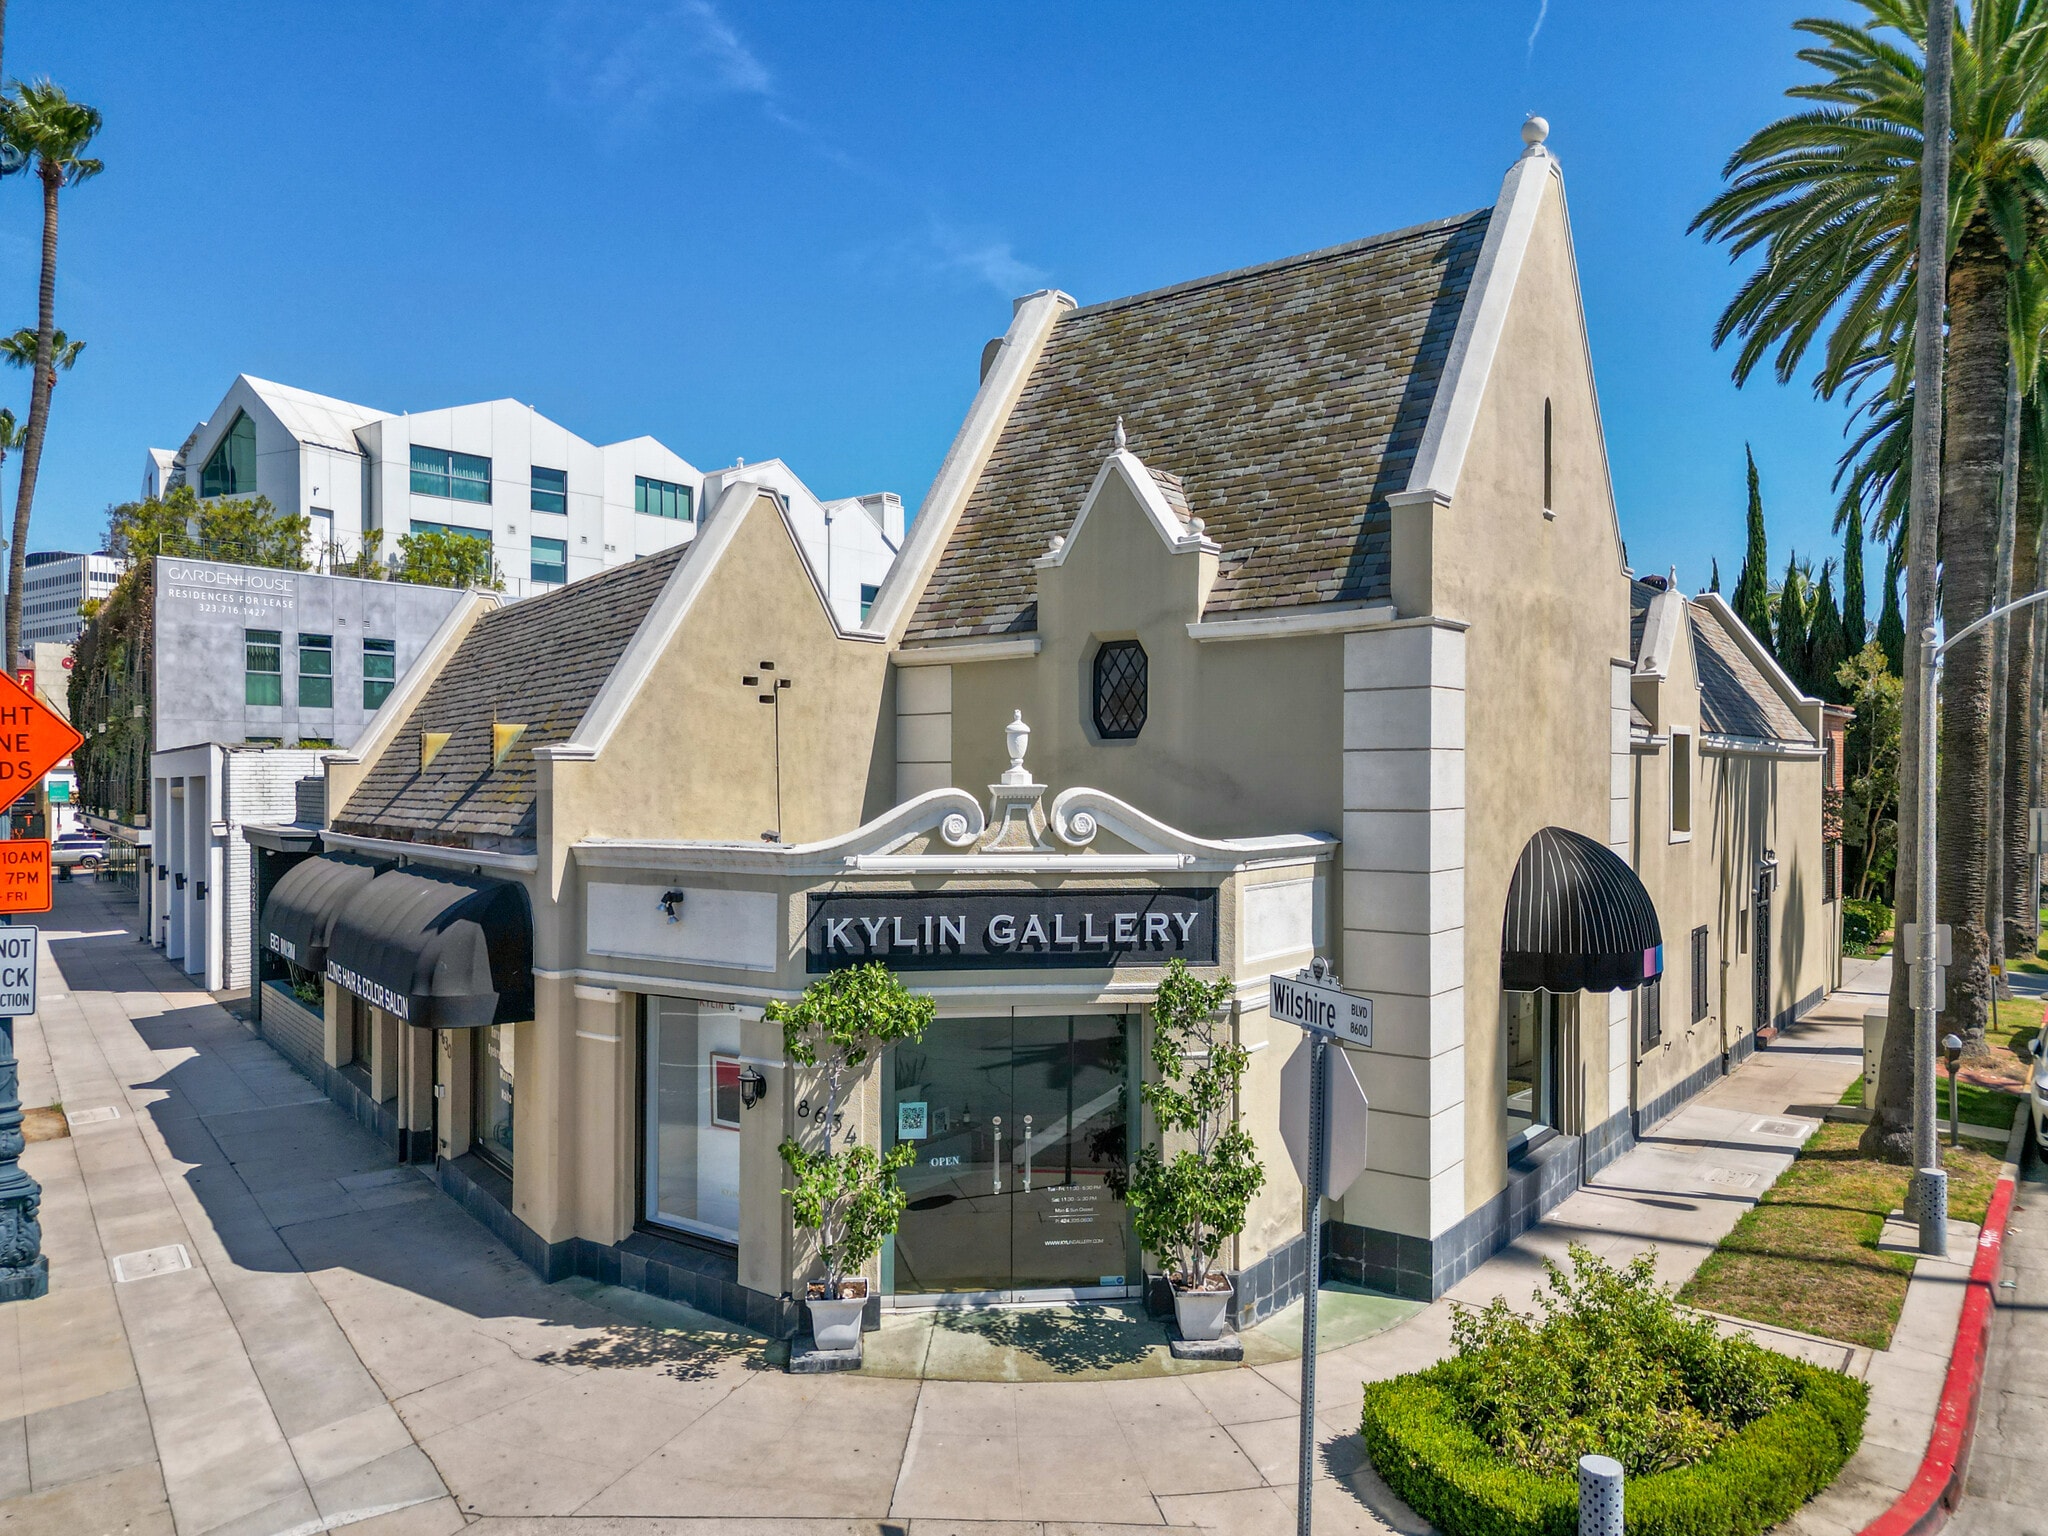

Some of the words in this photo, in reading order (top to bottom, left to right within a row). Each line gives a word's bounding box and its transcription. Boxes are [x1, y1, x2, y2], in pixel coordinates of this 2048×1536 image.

[168, 567, 293, 592] GARDENHOUSE
[168, 588, 234, 603] RESIDENCES
[239, 595, 259, 605] FOR
[263, 598, 293, 609] LEASE
[199, 603, 266, 617] 323.716.1427
[2, 850, 43, 865] 10AM
[5, 871, 39, 885] 7PM
[7, 891, 28, 901] FRI
[826, 914, 966, 948] KYLIN
[988, 911, 1199, 945] GALLERY
[327, 958, 342, 984] LONG
[342, 967, 357, 993] HAIR
[362, 976, 385, 1008] COLOR
[385, 989, 409, 1020] SALON
[1273, 981, 1336, 1029] Wilshire
[1351, 1003, 1368, 1019] BLVD
[1350, 1022, 1368, 1038] 8600
[797, 1099, 857, 1144] 8634
[929, 1155, 961, 1167] OPEN
